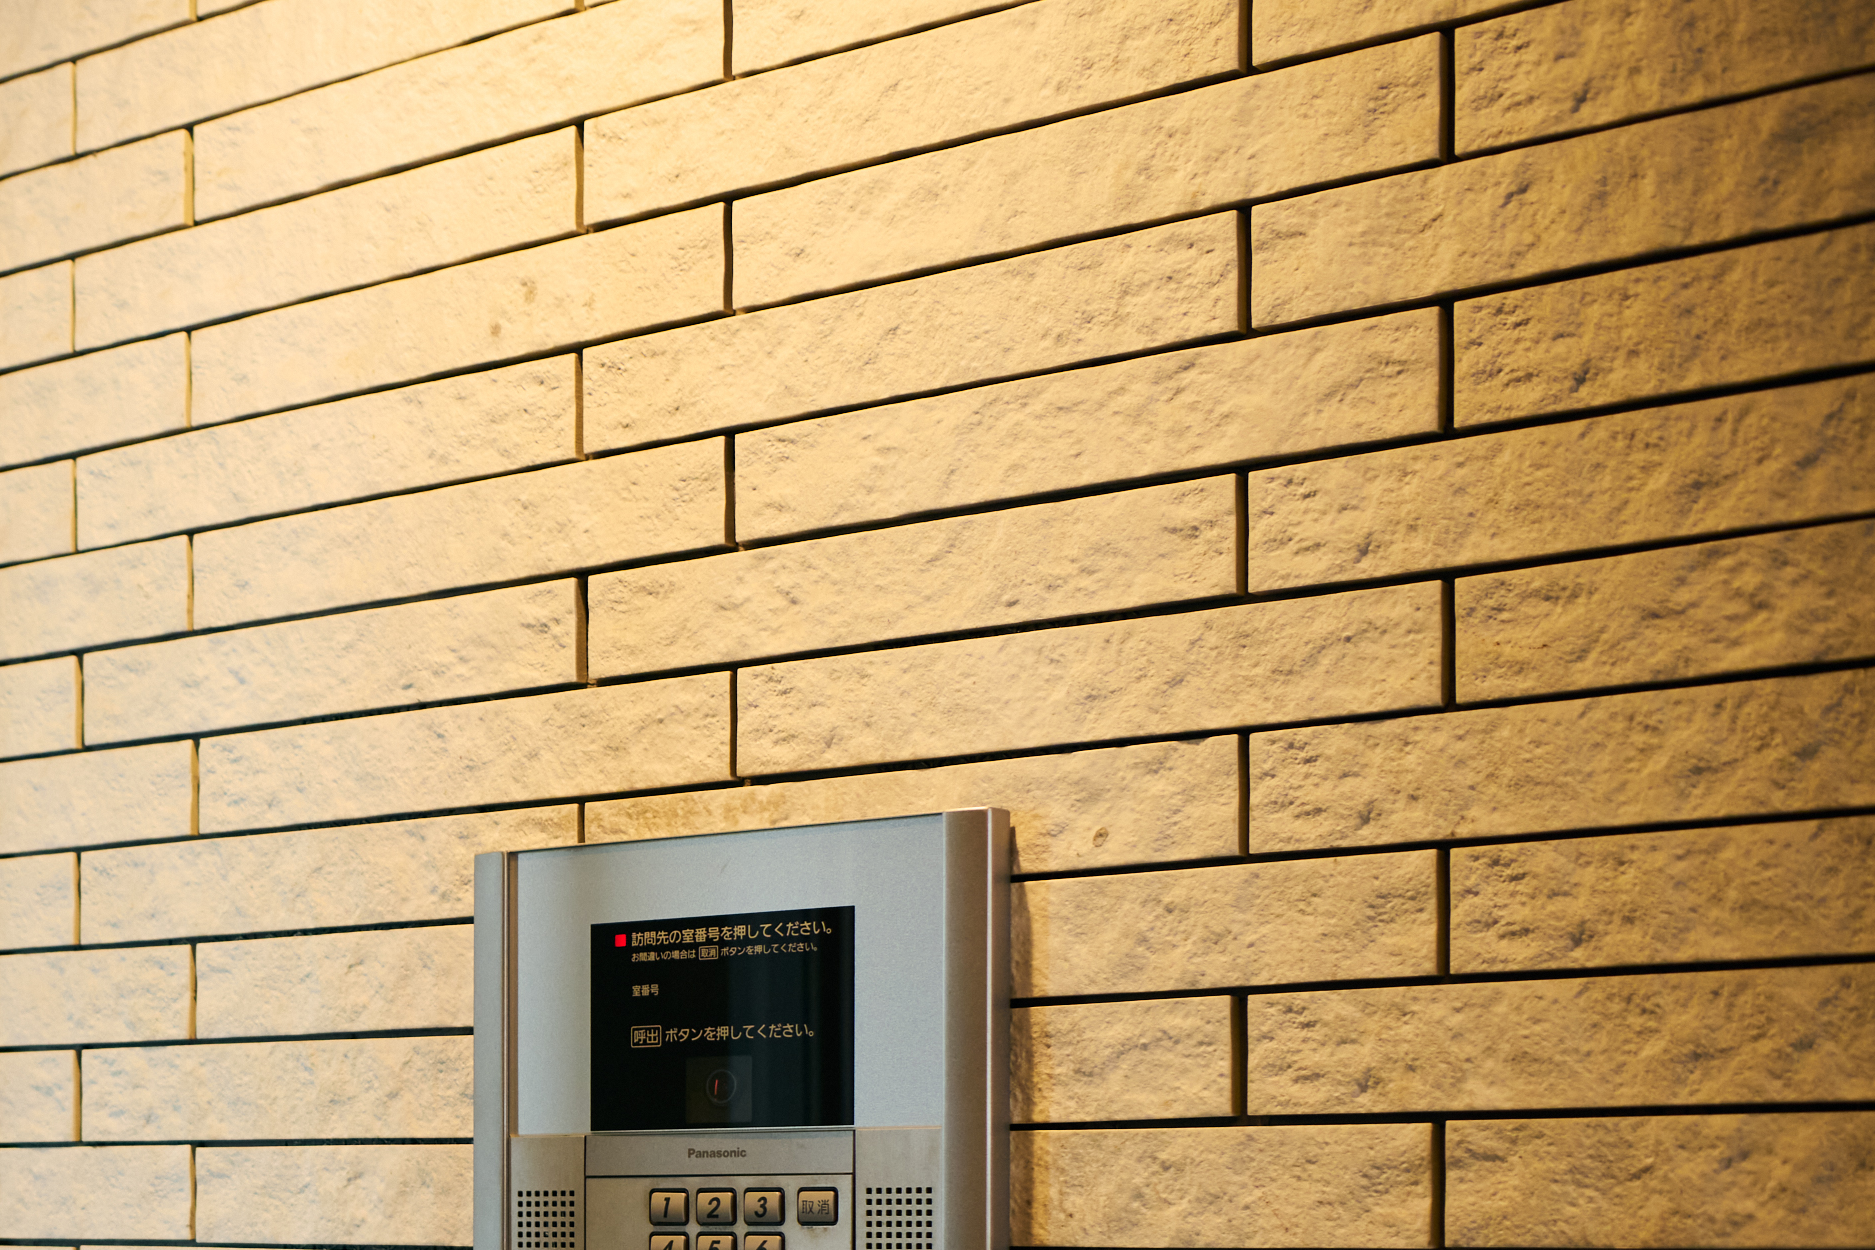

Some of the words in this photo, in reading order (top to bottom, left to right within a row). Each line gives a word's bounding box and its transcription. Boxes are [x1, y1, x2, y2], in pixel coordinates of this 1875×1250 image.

[631, 921, 832, 947] 訪問先の室番号を押してください。
[631, 949, 696, 962] お間違いの場合は
[720, 943, 817, 957] ボタンを押してください。
[632, 984, 659, 997] 室番号
[633, 1029, 658, 1045] 呼出
[665, 1023, 815, 1042] ボタンを押してください。
[687, 1147, 747, 1159] Panasonic
[663, 1197, 671, 1218] 1
[706, 1197, 721, 1218] 2
[754, 1196, 768, 1218] 3
[801, 1199, 830, 1215] 取消
